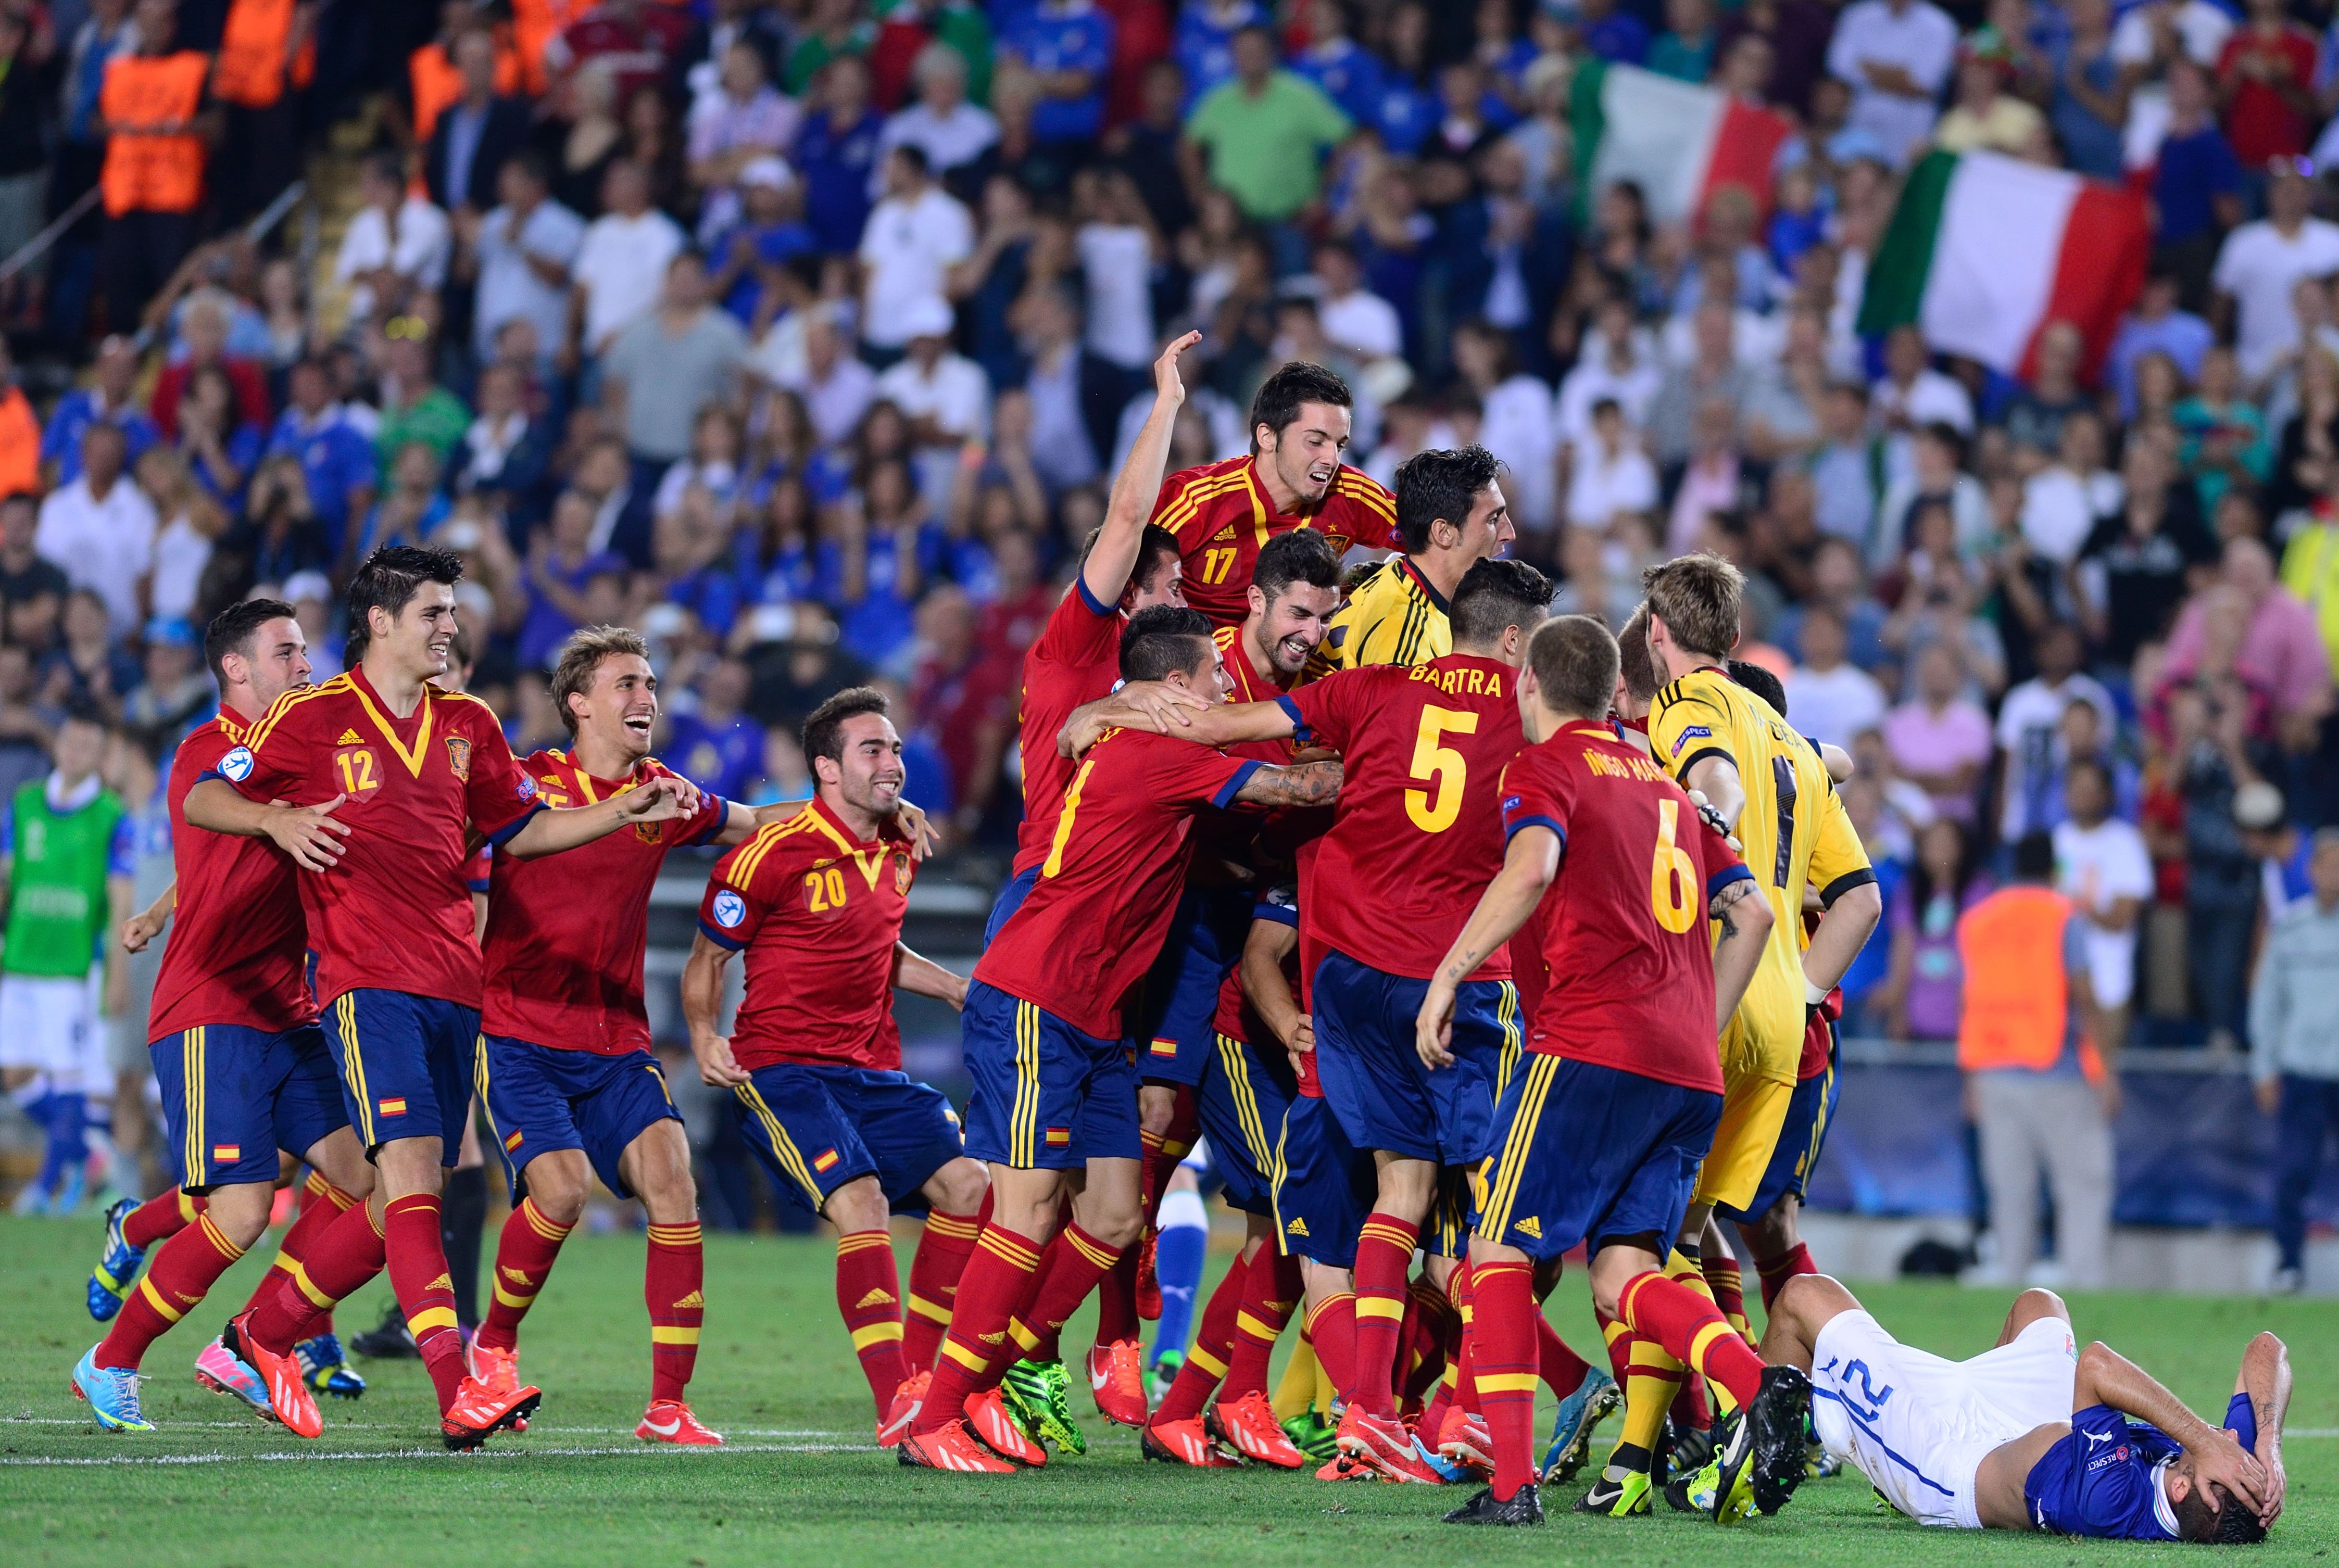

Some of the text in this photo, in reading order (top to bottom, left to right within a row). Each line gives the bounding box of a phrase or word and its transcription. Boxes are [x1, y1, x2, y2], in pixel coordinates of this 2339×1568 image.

[1202, 548, 1237, 584] 17
[1409, 665, 1502, 698] BARTRA
[1679, 727, 1711, 745] RESPECT
[337, 750, 378, 793] 12
[1405, 703, 1479, 833] 5
[1651, 799, 1699, 934] 6
[806, 868, 847, 913] 20
[1475, 1155, 1494, 1214] 6
[1287, 1228, 1310, 1237] adidas
[1514, 1223, 1542, 1239] adidas
[2088, 1453, 2117, 1471] RESPECT
